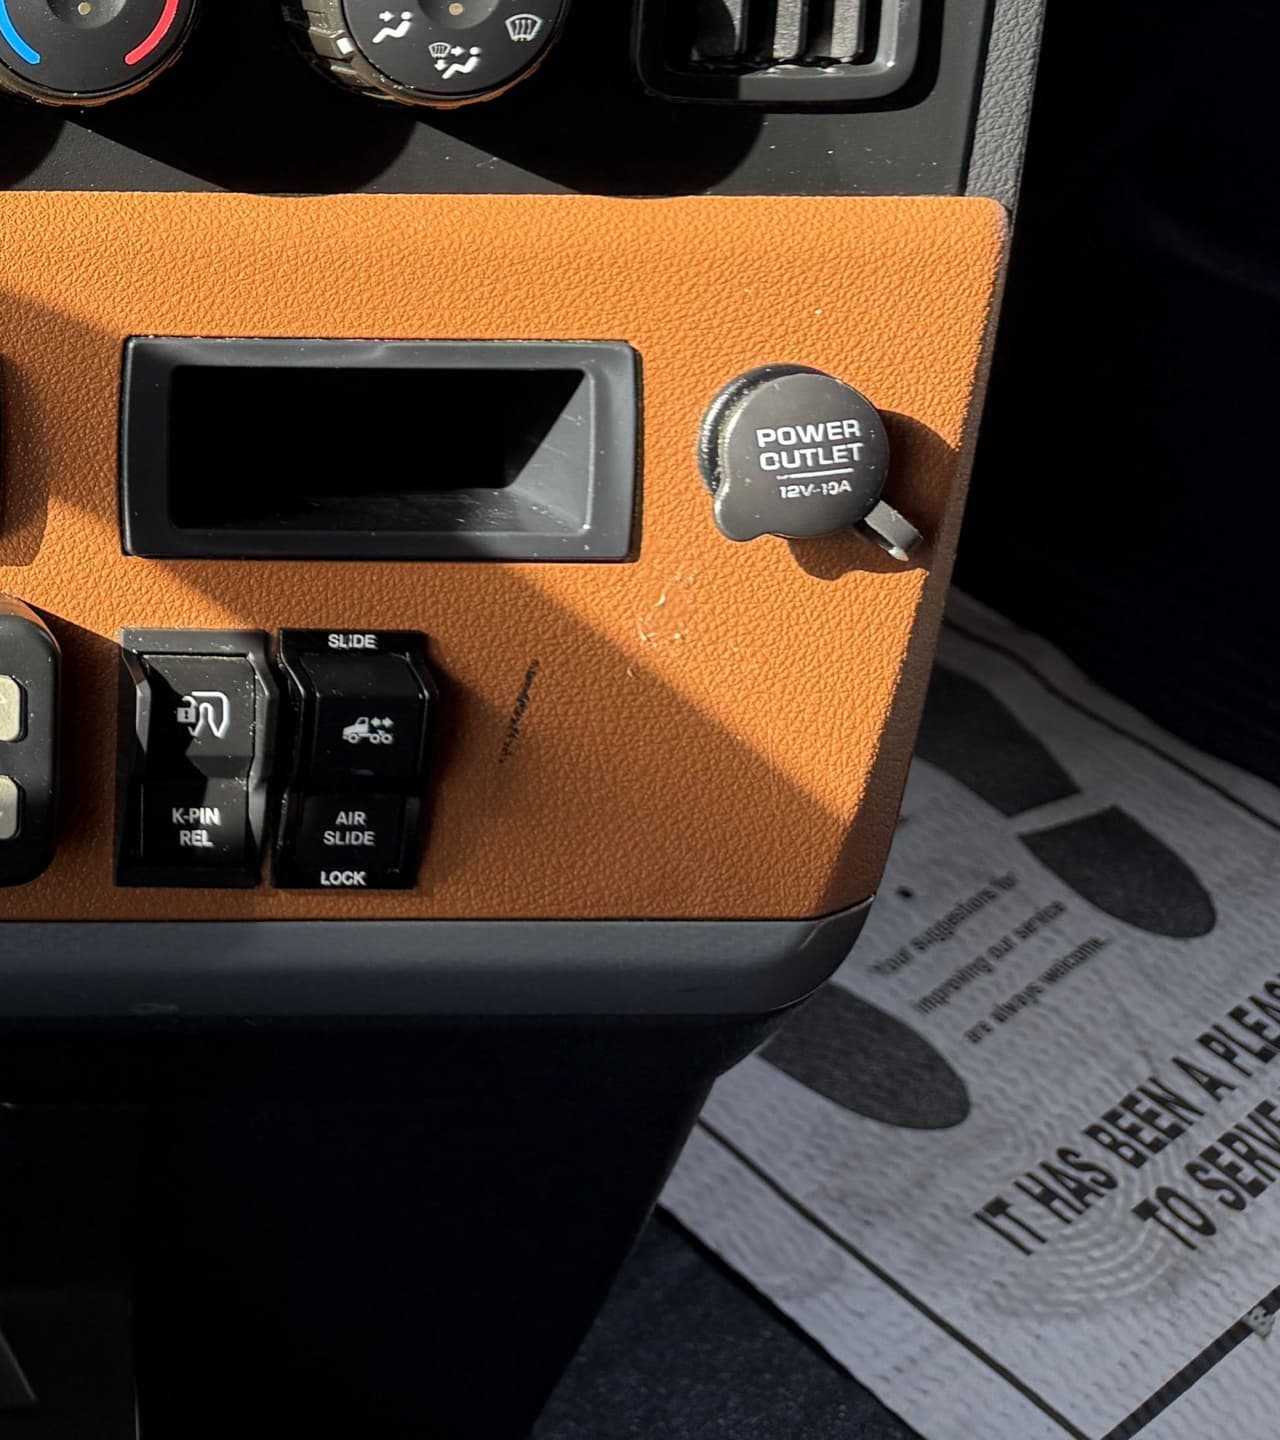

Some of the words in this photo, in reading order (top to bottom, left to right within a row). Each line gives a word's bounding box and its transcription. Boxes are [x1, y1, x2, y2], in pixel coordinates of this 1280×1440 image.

[756, 419, 862, 447] POWER
[760, 443, 864, 471] OUTLET
[779, 480, 852, 498] 12V-10A
[328, 634, 377, 649] SLIDE
[172, 807, 222, 826] K-PIN
[335, 811, 366, 826] AIR
[180, 829, 213, 847] REL
[323, 831, 375, 846] SLIDE
[320, 870, 366, 886] LOCK
[1195, 973, 1280, 1078] PLEA
[1172, 1056, 1236, 1103] A
[1082, 1076, 1205, 1169] BEEN
[1014, 1146, 1119, 1224] HAS
[972, 1196, 1048, 1256] IT
[1131, 1185, 1218, 1250] TO
